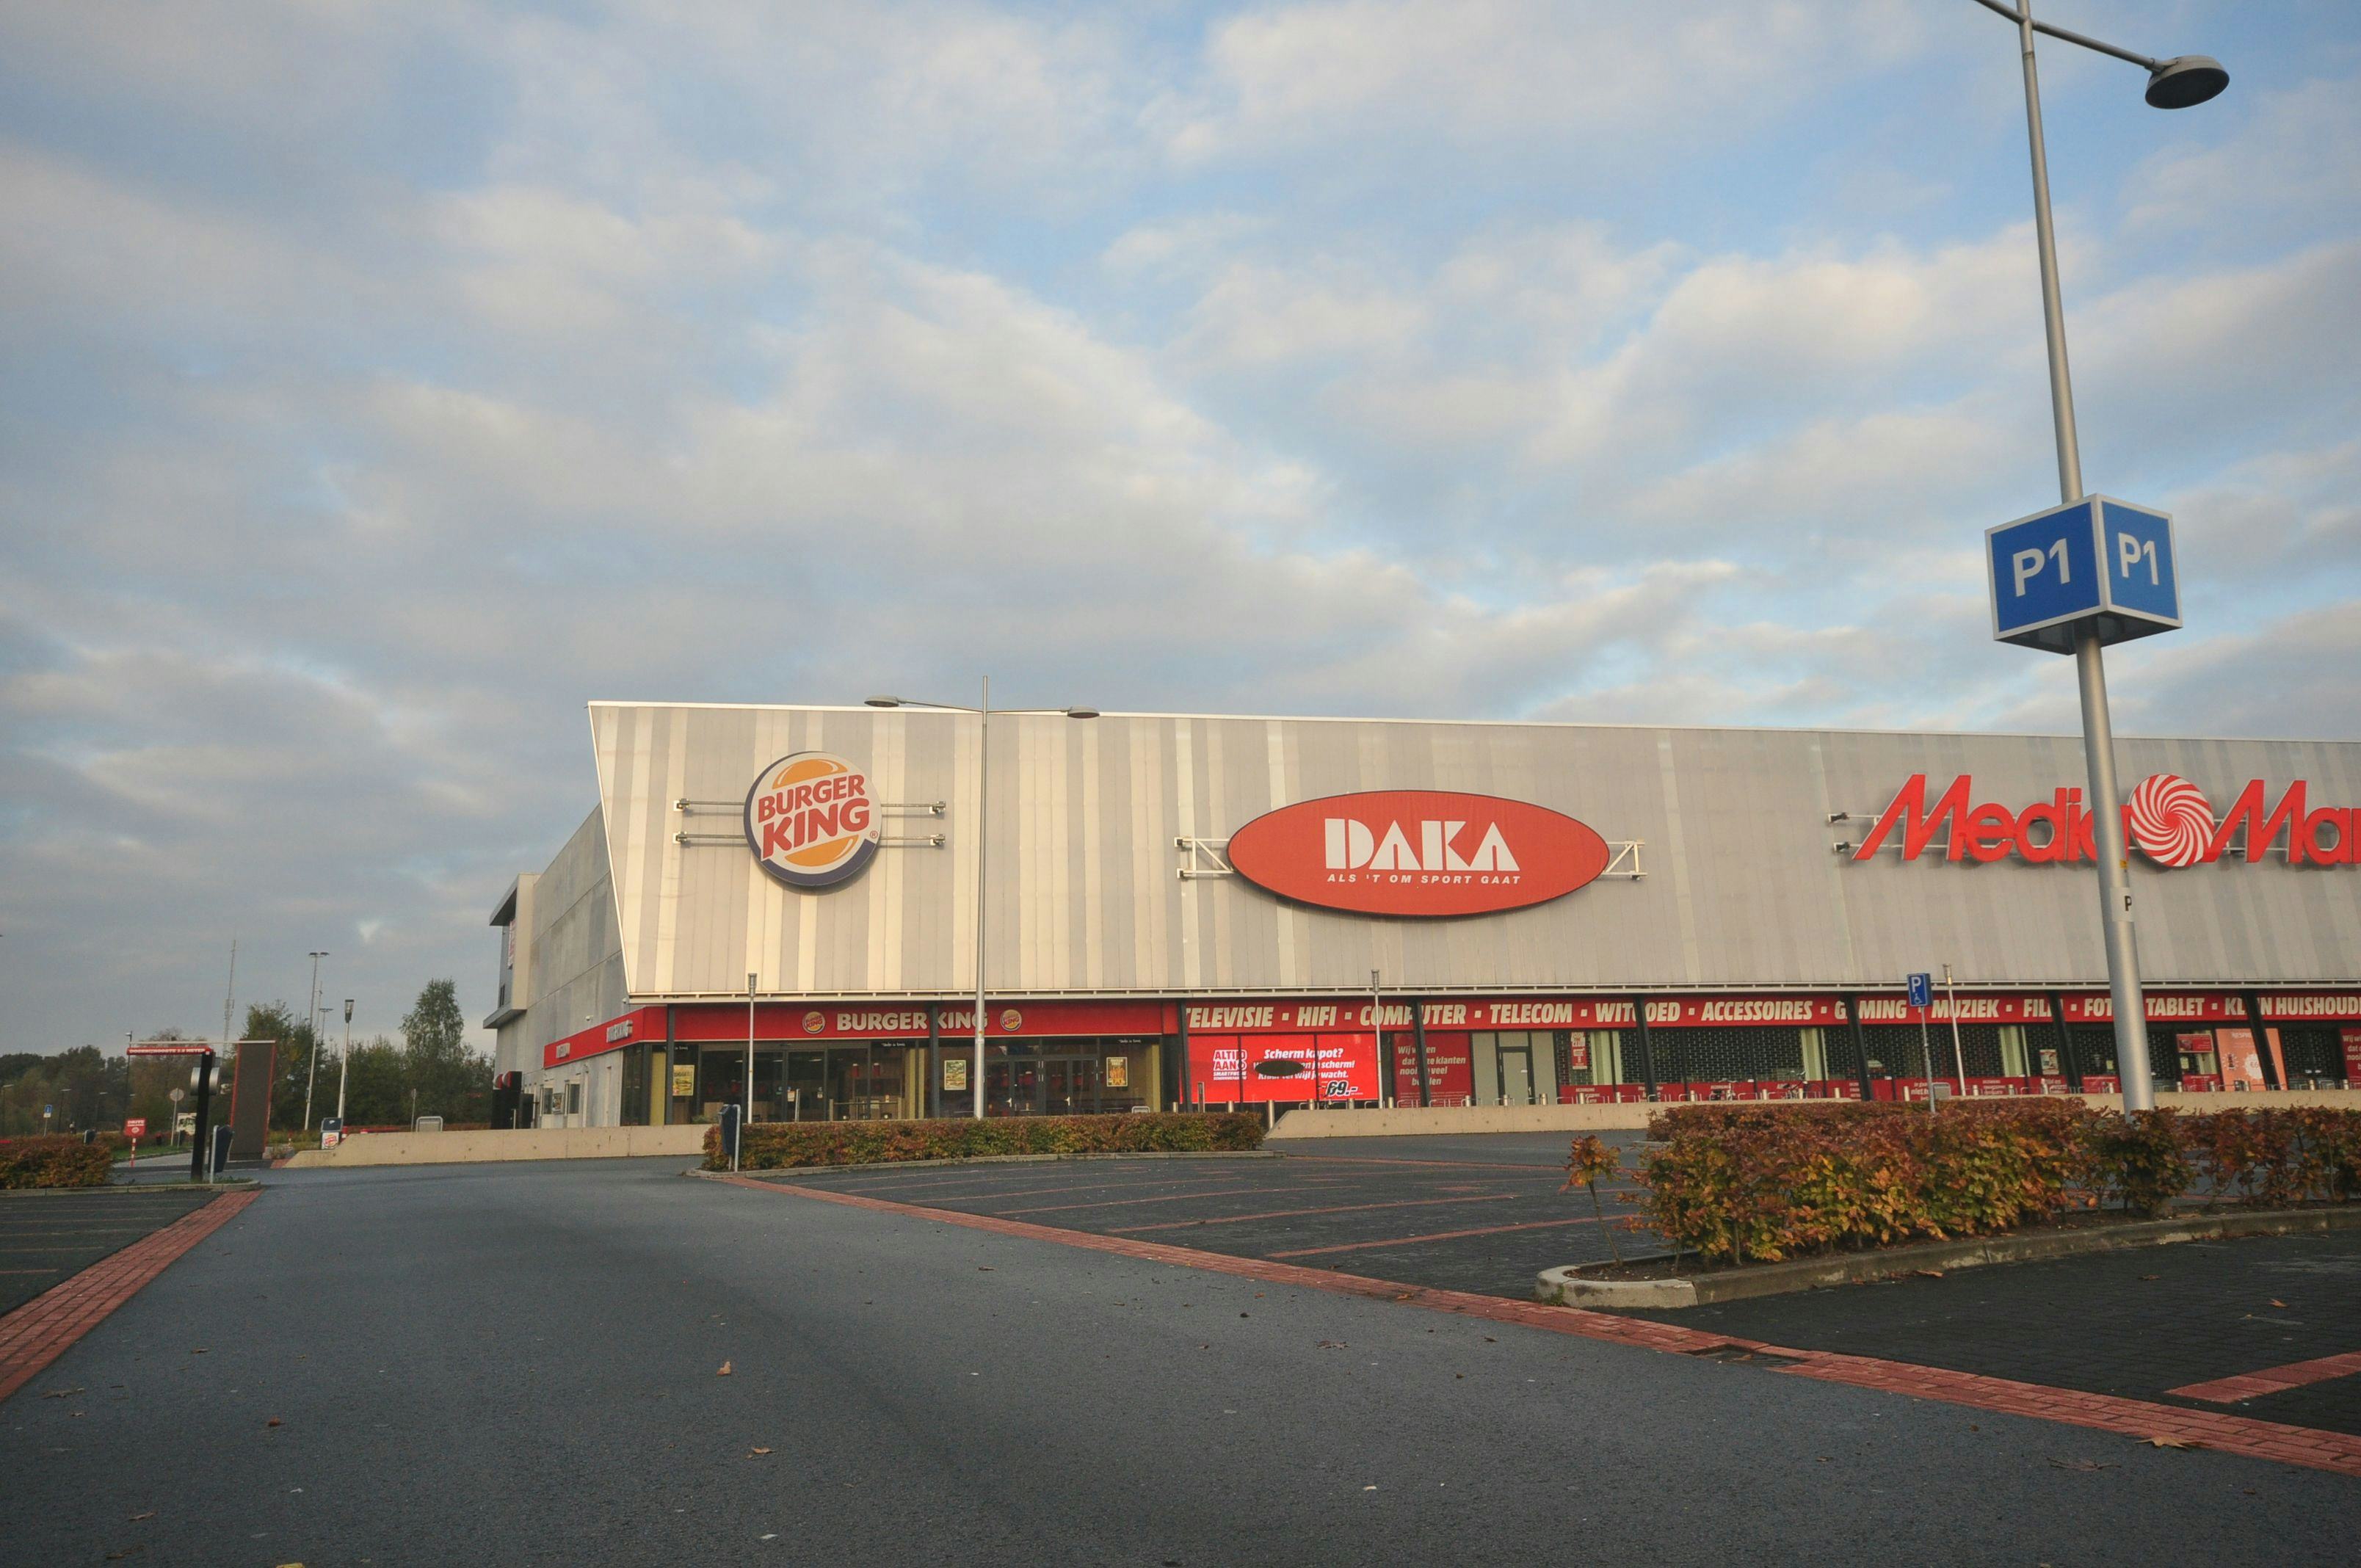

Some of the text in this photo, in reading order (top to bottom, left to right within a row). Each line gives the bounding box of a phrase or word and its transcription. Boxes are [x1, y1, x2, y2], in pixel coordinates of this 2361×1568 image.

[2118, 532, 2158, 585] P1
[2013, 538, 2070, 597] P1
[758, 774, 865, 824] BURGER
[763, 798, 870, 859] KING
[1324, 819, 1520, 871] DAKA
[1327, 874, 1521, 884] ALS 'T OM SPORT GAAT
[1911, 976, 1921, 992] P
[1296, 1006, 1337, 1026] HIFI
[1490, 1003, 1573, 1023] TELECOM
[1701, 1001, 1813, 1021] ACCESSOIRES
[1835, 1000, 1907, 1020] GMING
[1931, 999, 2000, 1019] MUZIEK
[2145, 998, 2205, 1017] TABLET
[837, 1012, 928, 1031] BURGER
[1263, 1049, 1304, 1059] Scherm
[1398, 1045, 1410, 1055] Wij
[1321, 1060, 1355, 1069] scherm!
[1402, 1057, 1416, 1065] dat
[1435, 1056, 1466, 1064] klanten
[1321, 1070, 1349, 1078] wacht.
[1431, 1066, 1448, 1075] veel
